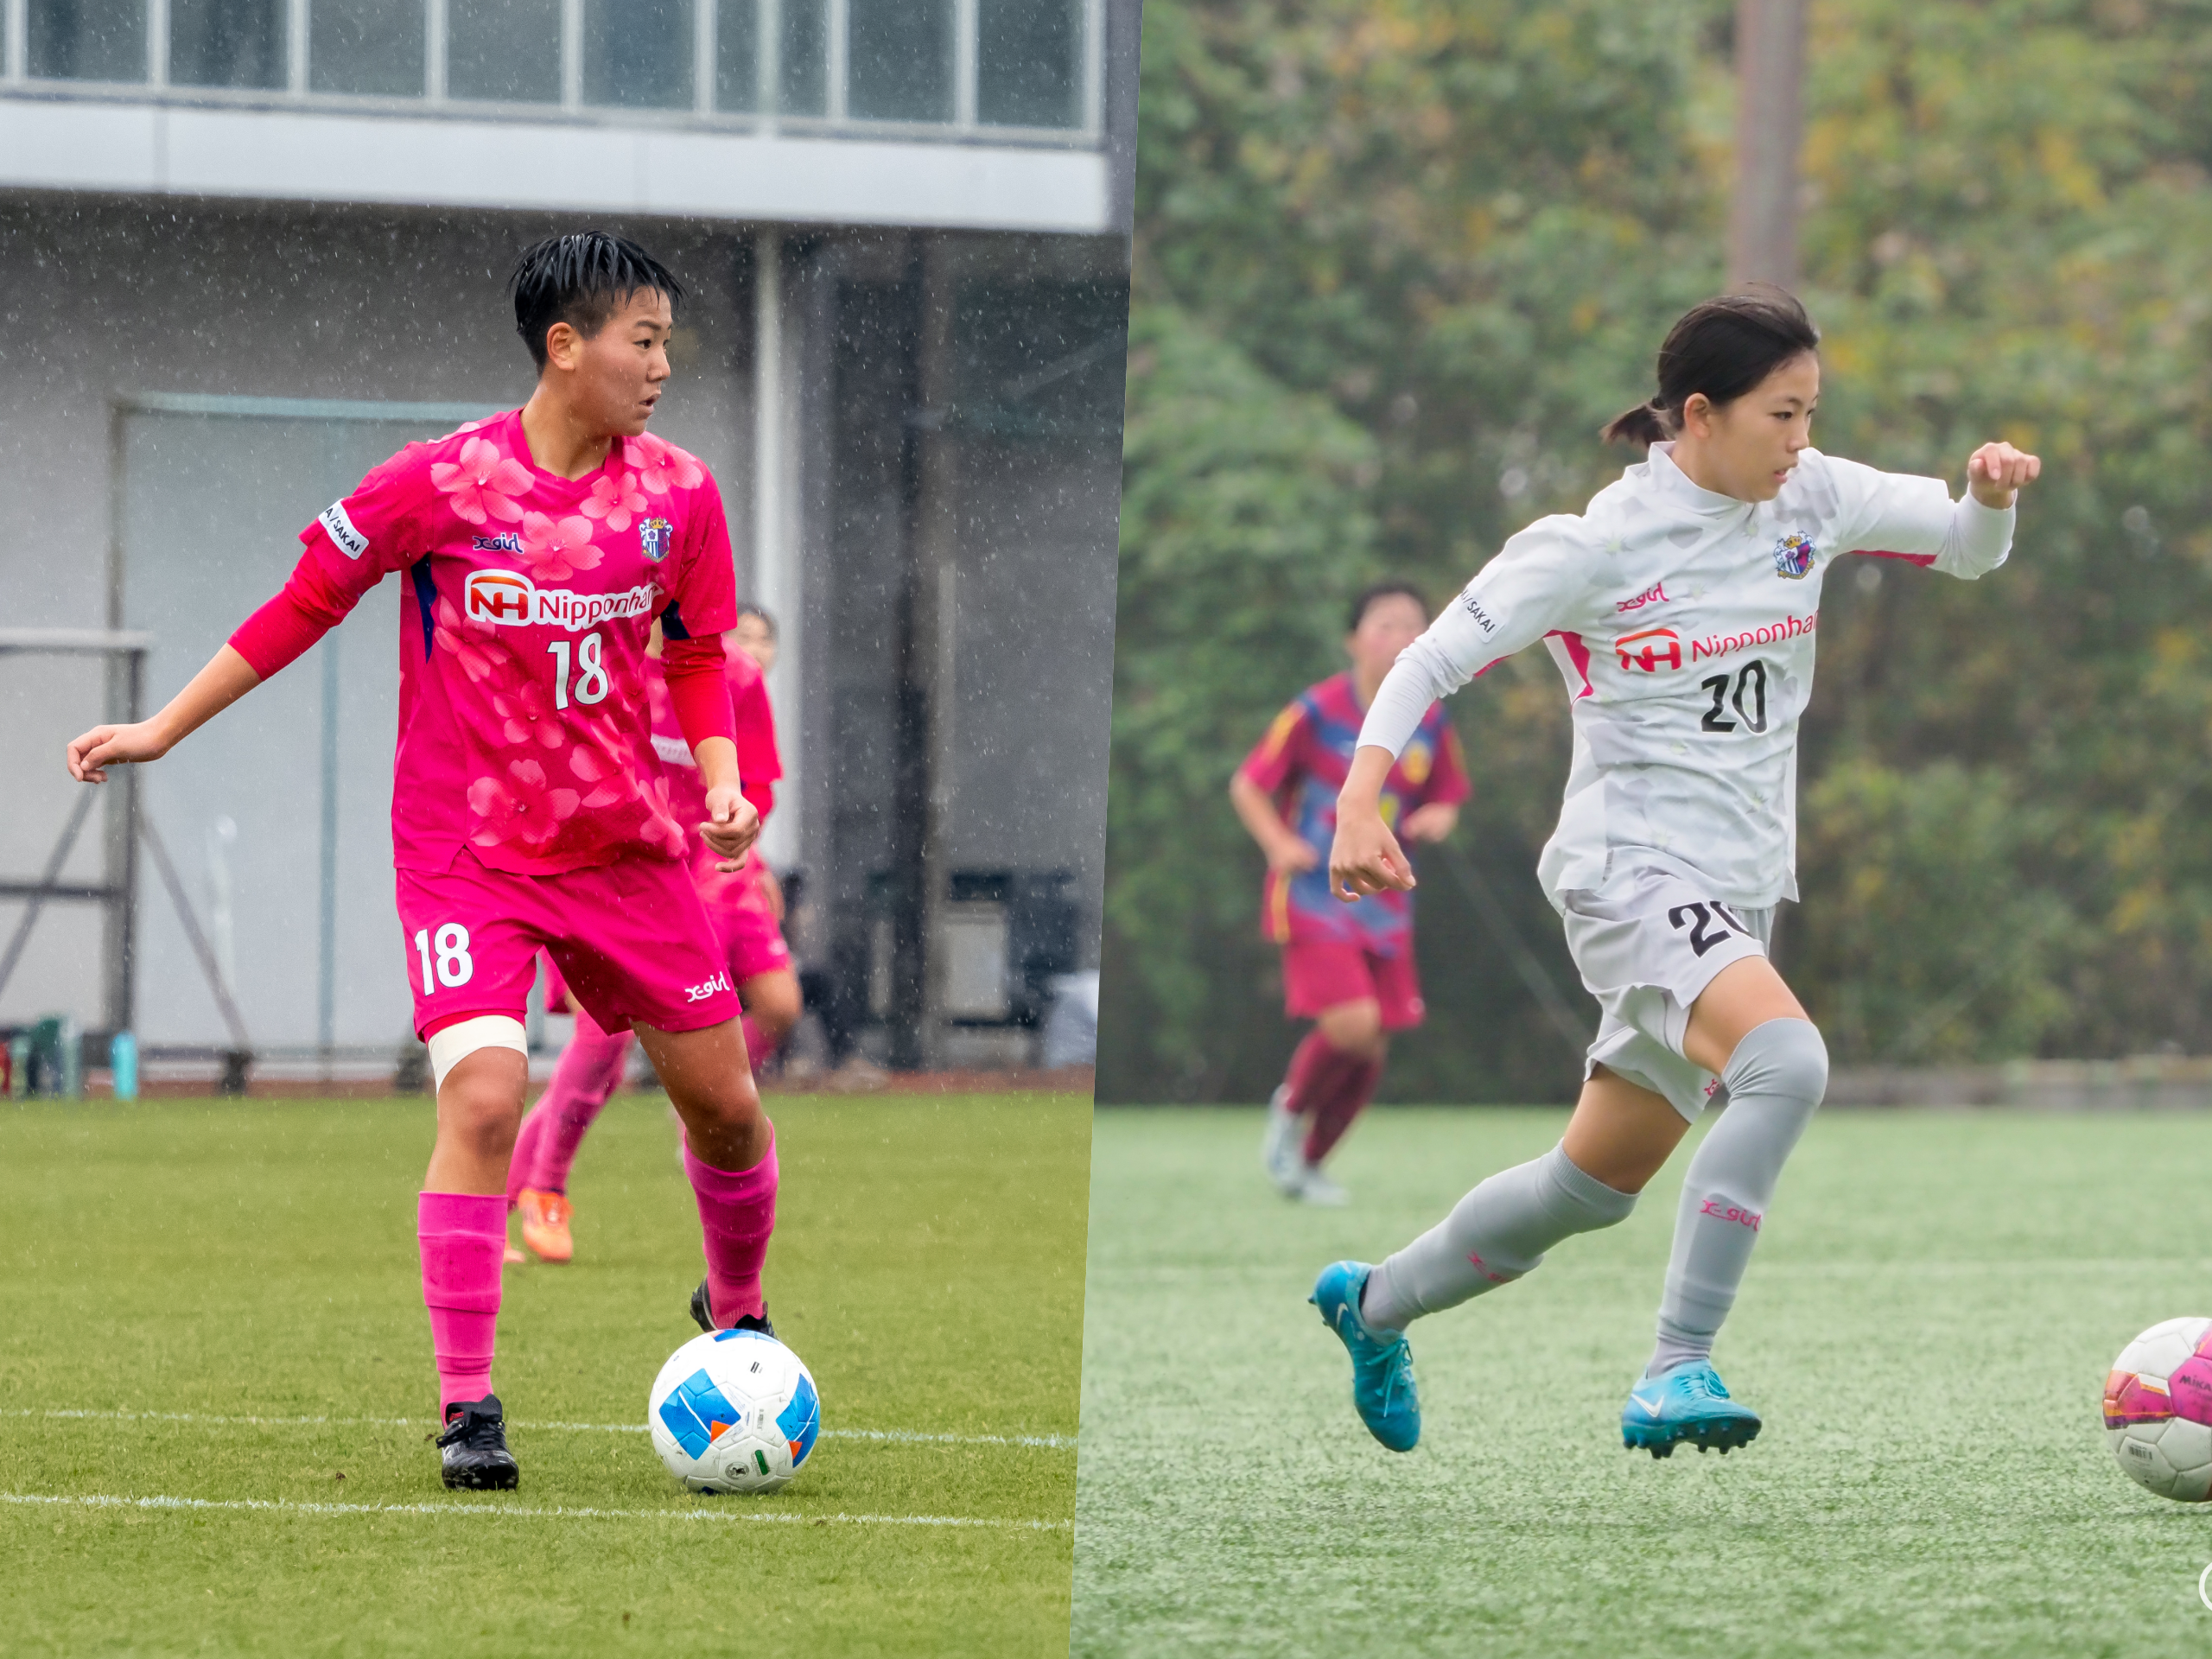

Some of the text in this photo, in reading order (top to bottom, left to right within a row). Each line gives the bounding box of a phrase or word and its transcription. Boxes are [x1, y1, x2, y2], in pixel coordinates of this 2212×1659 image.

[334, 519, 360, 552] SAKAI
[1467, 601, 1496, 633] SAKAI
[548, 632, 608, 709] 18
[1700, 659, 1768, 734] 20
[415, 923, 474, 996] 18
